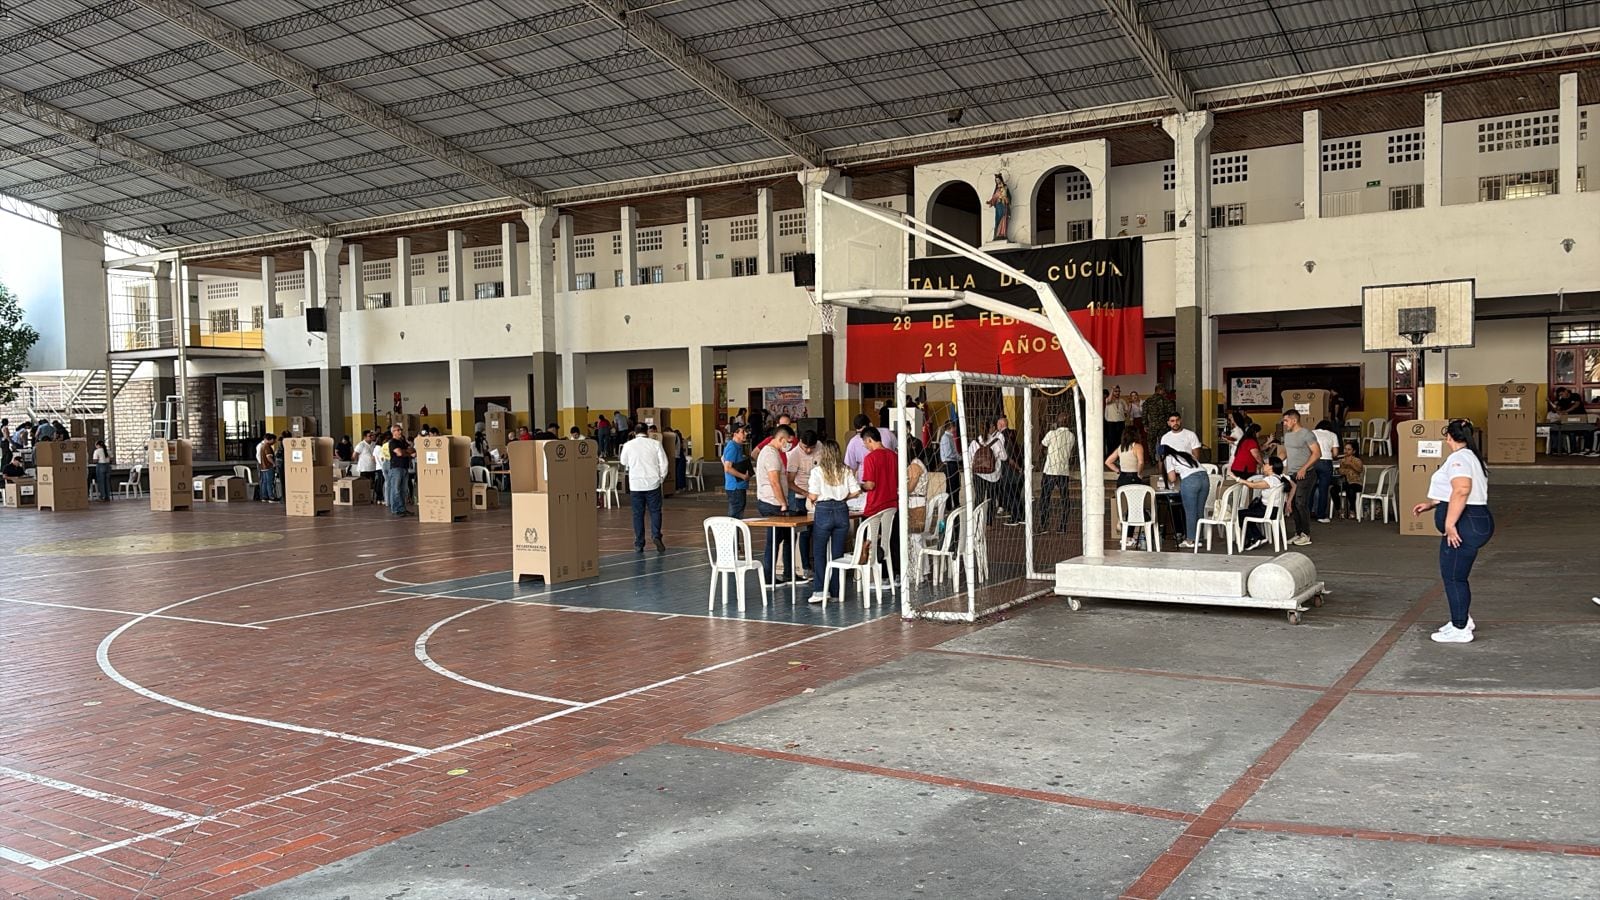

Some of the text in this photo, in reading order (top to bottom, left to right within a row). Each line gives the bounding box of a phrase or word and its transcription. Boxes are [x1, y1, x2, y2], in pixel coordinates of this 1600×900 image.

[911, 273, 976, 290] TALLA
[893, 316, 911, 330] 28
[932, 313, 955, 329] DE
[923, 334, 1061, 357] 213 AÑOS
